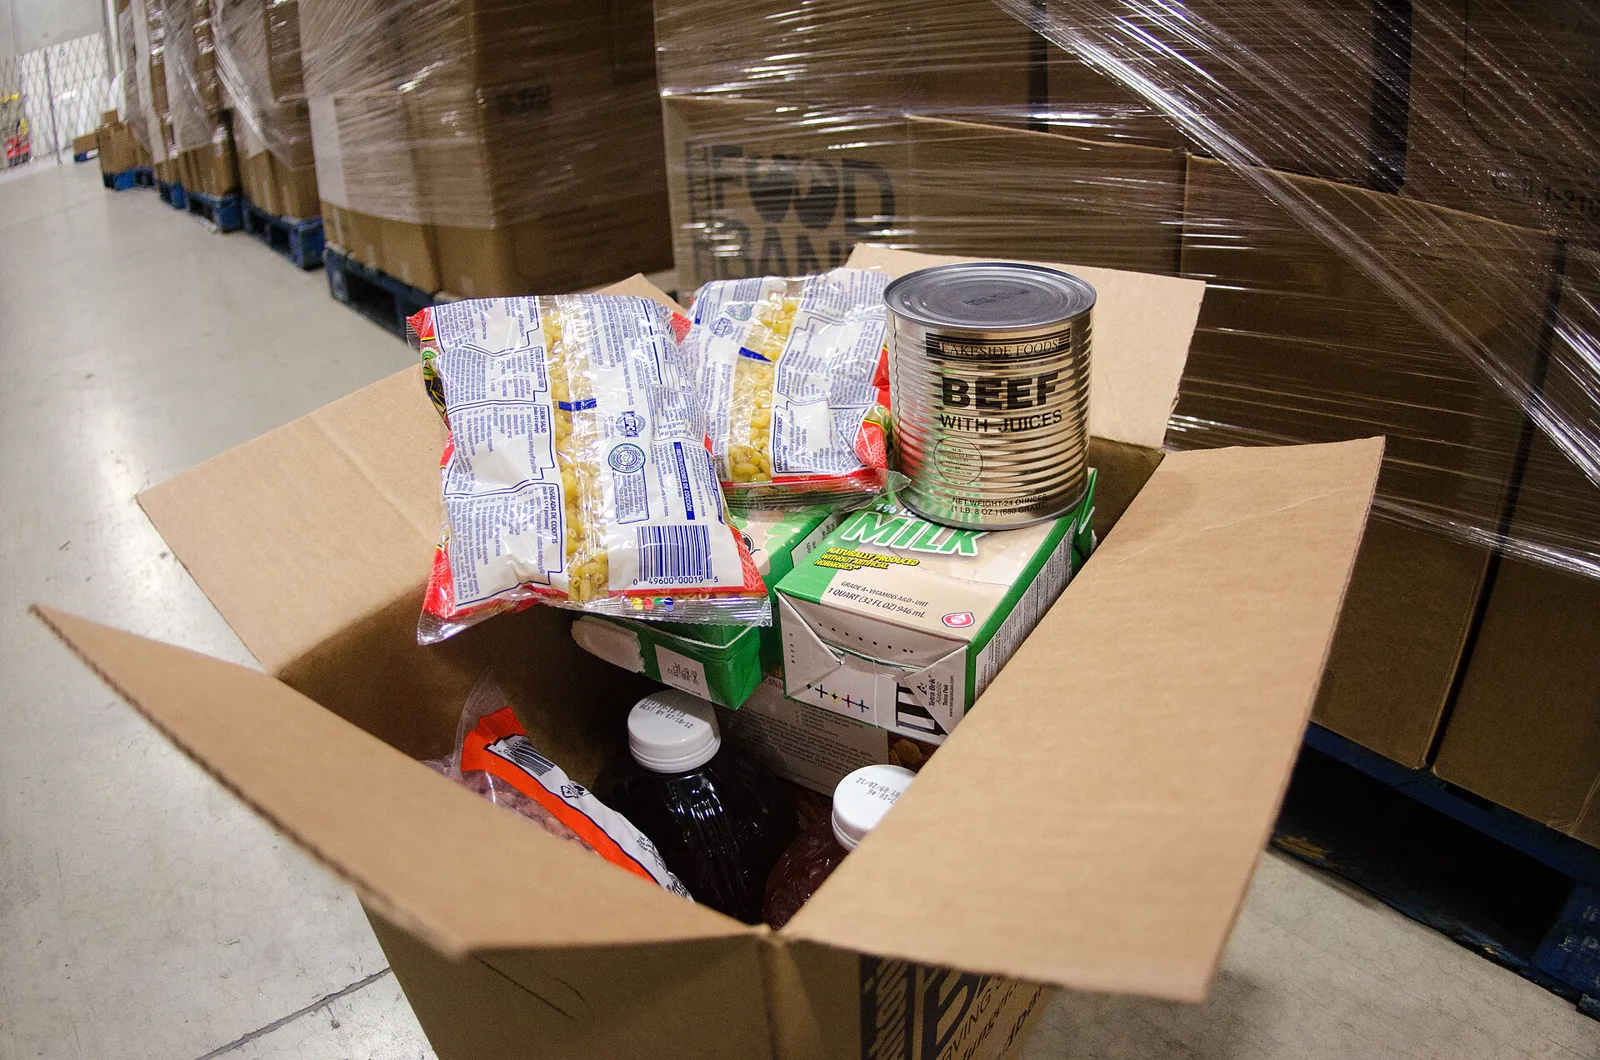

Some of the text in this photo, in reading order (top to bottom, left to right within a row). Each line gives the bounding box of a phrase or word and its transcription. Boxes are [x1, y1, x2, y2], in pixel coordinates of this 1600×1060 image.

[938, 338, 1060, 357] LAKESIDE FOODS
[941, 372, 1059, 410] BEEF
[940, 409, 1063, 432] WITH JUICES
[548, 486, 556, 512] ENSALADA
[875, 503, 897, 514] 1%
[952, 496, 969, 506] NET
[969, 499, 1002, 508] WEIGHT
[1015, 494, 1048, 506] OUNCES
[982, 508, 999, 516] OZ.)
[1000, 507, 1016, 516] (680
[1017, 502, 1048, 515] GRAMS)
[840, 511, 990, 557] MILK
[820, 553, 890, 570] WITHOUT ARTIFICIAL
[826, 547, 920, 567] NATURALLY PRODUCED
[633, 578, 638, 586] 0
[678, 576, 704, 584] 00019
[833, 589, 859, 602] QUART
[859, 595, 872, 606] (32
[872, 599, 882, 607] FL
[882, 601, 897, 613] OZ)
[897, 605, 912, 615] 946
[913, 611, 927, 619] mL
[841, 581, 861, 592] GRADE
[869, 588, 899, 602] VITAMINS
[915, 600, 929, 608] UHT
[638, 703, 654, 713] BEST
[928, 691, 936, 708] Tetra
